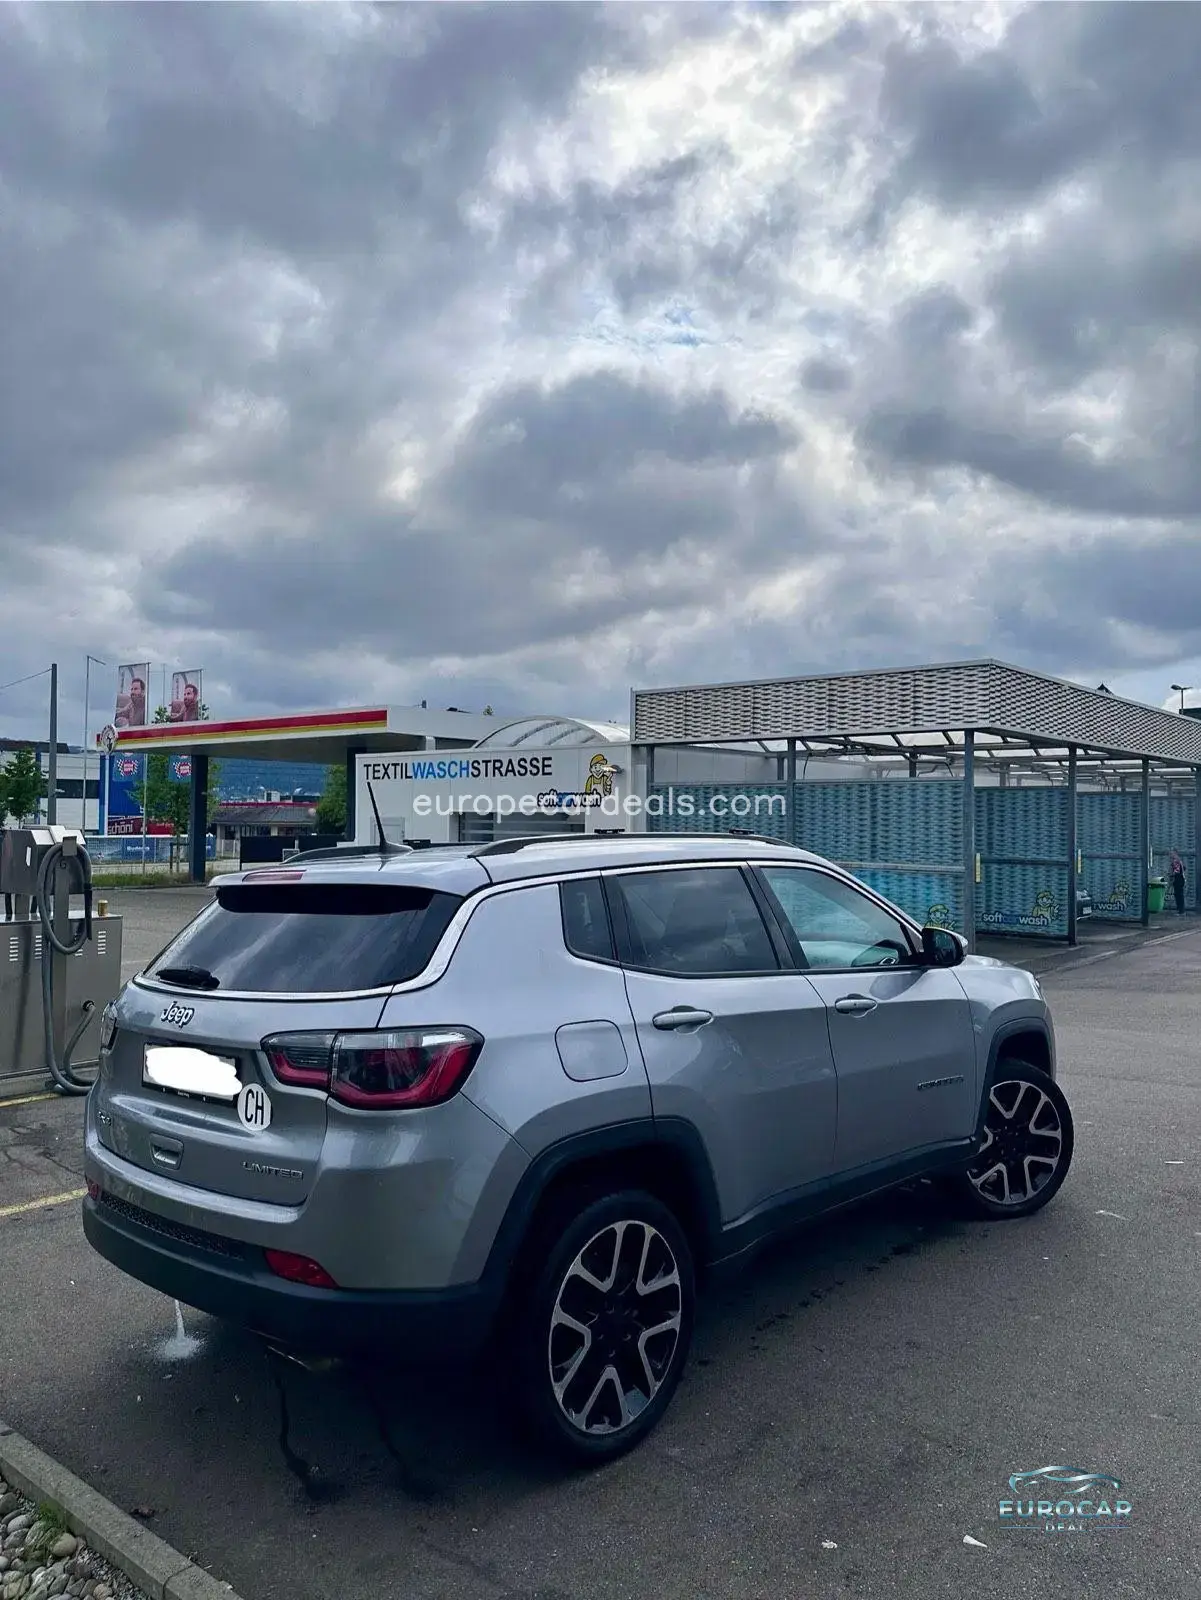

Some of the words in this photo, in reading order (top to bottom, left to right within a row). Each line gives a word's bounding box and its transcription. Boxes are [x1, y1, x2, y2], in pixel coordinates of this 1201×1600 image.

[364, 757, 553, 780] TEXTILWASCHSTRASSE
[161, 1001, 195, 1028] Jeep
[245, 1089, 265, 1126] CH
[242, 1161, 304, 1180] LIMITED
